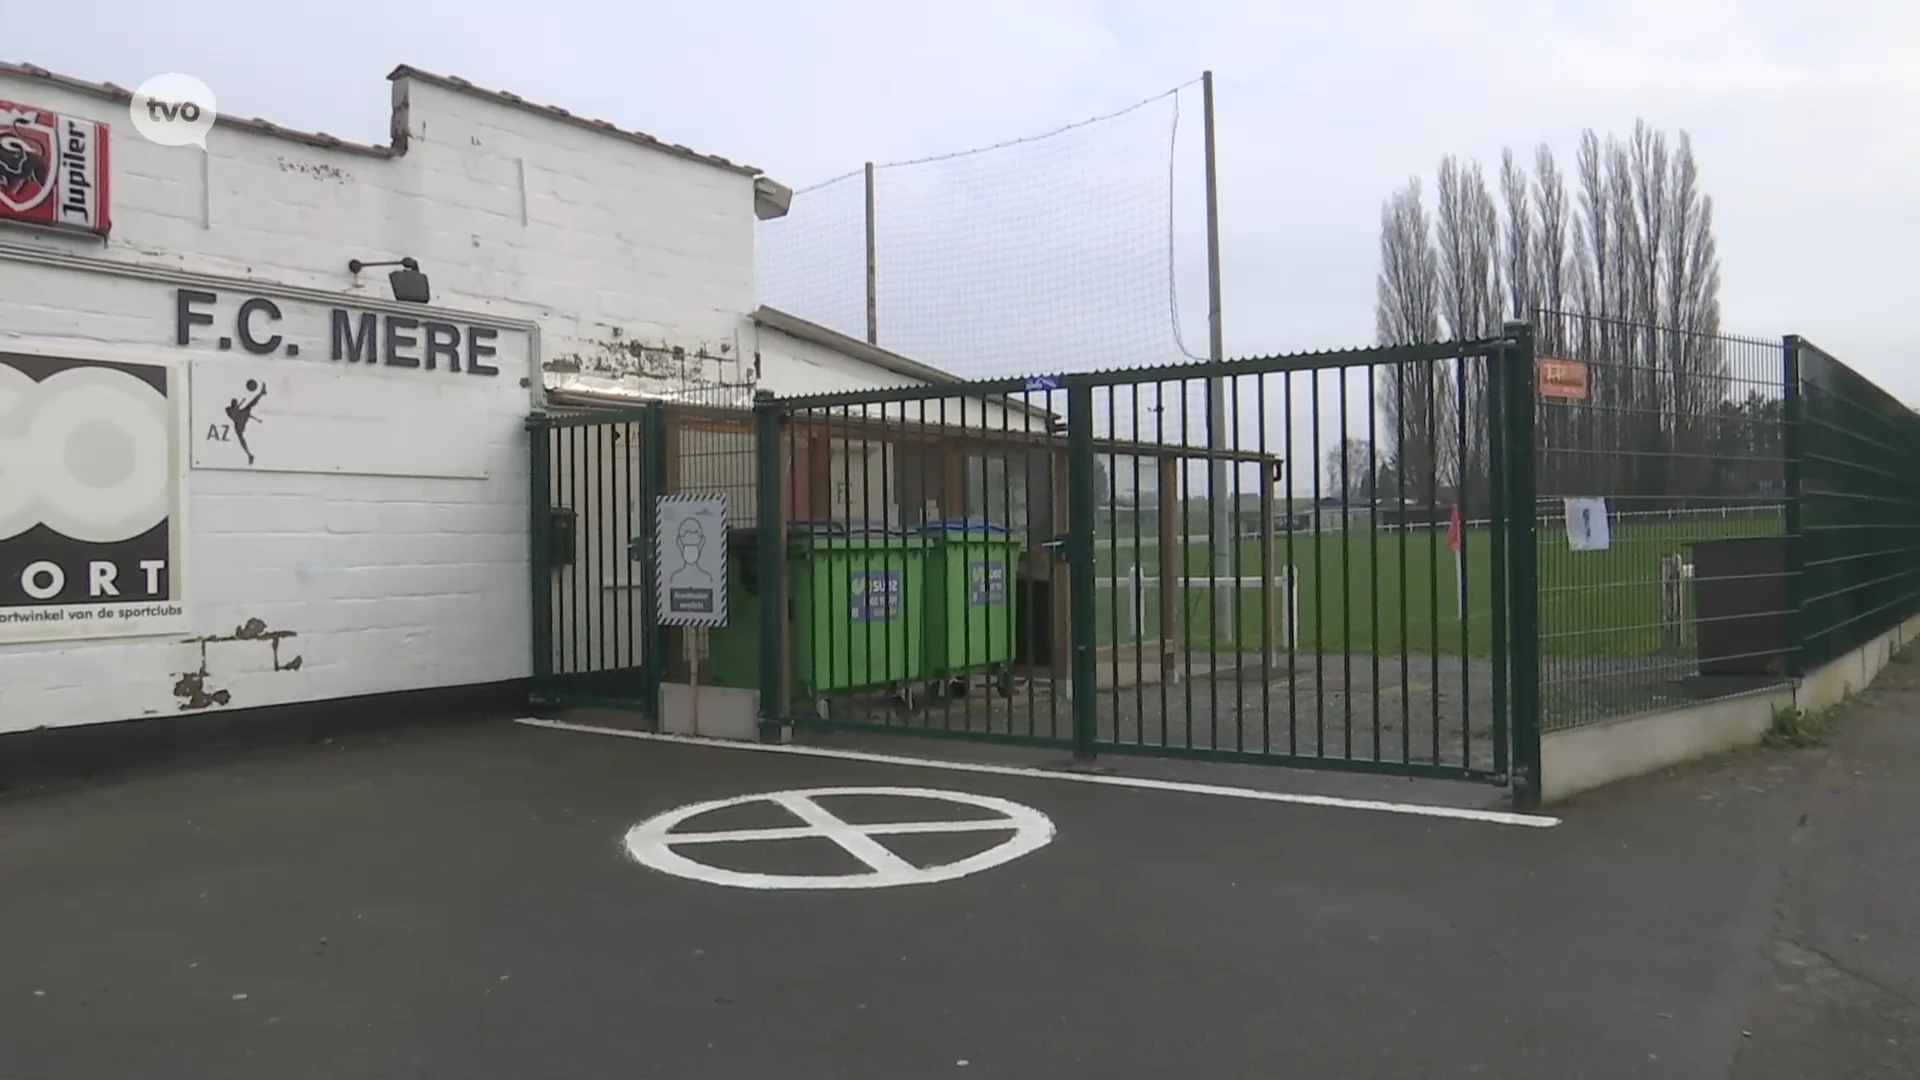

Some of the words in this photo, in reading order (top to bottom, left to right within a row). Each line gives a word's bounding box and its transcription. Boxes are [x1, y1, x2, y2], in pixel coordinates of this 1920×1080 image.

[63, 120, 91, 224] Jupiler
[177, 288, 299, 355] F.C.
[332, 308, 499, 376] MERE
[207, 423, 231, 441] AZ
[68, 611, 93, 621] van
[97, 608, 114, 619] de
[118, 605, 183, 620] sportclubs
